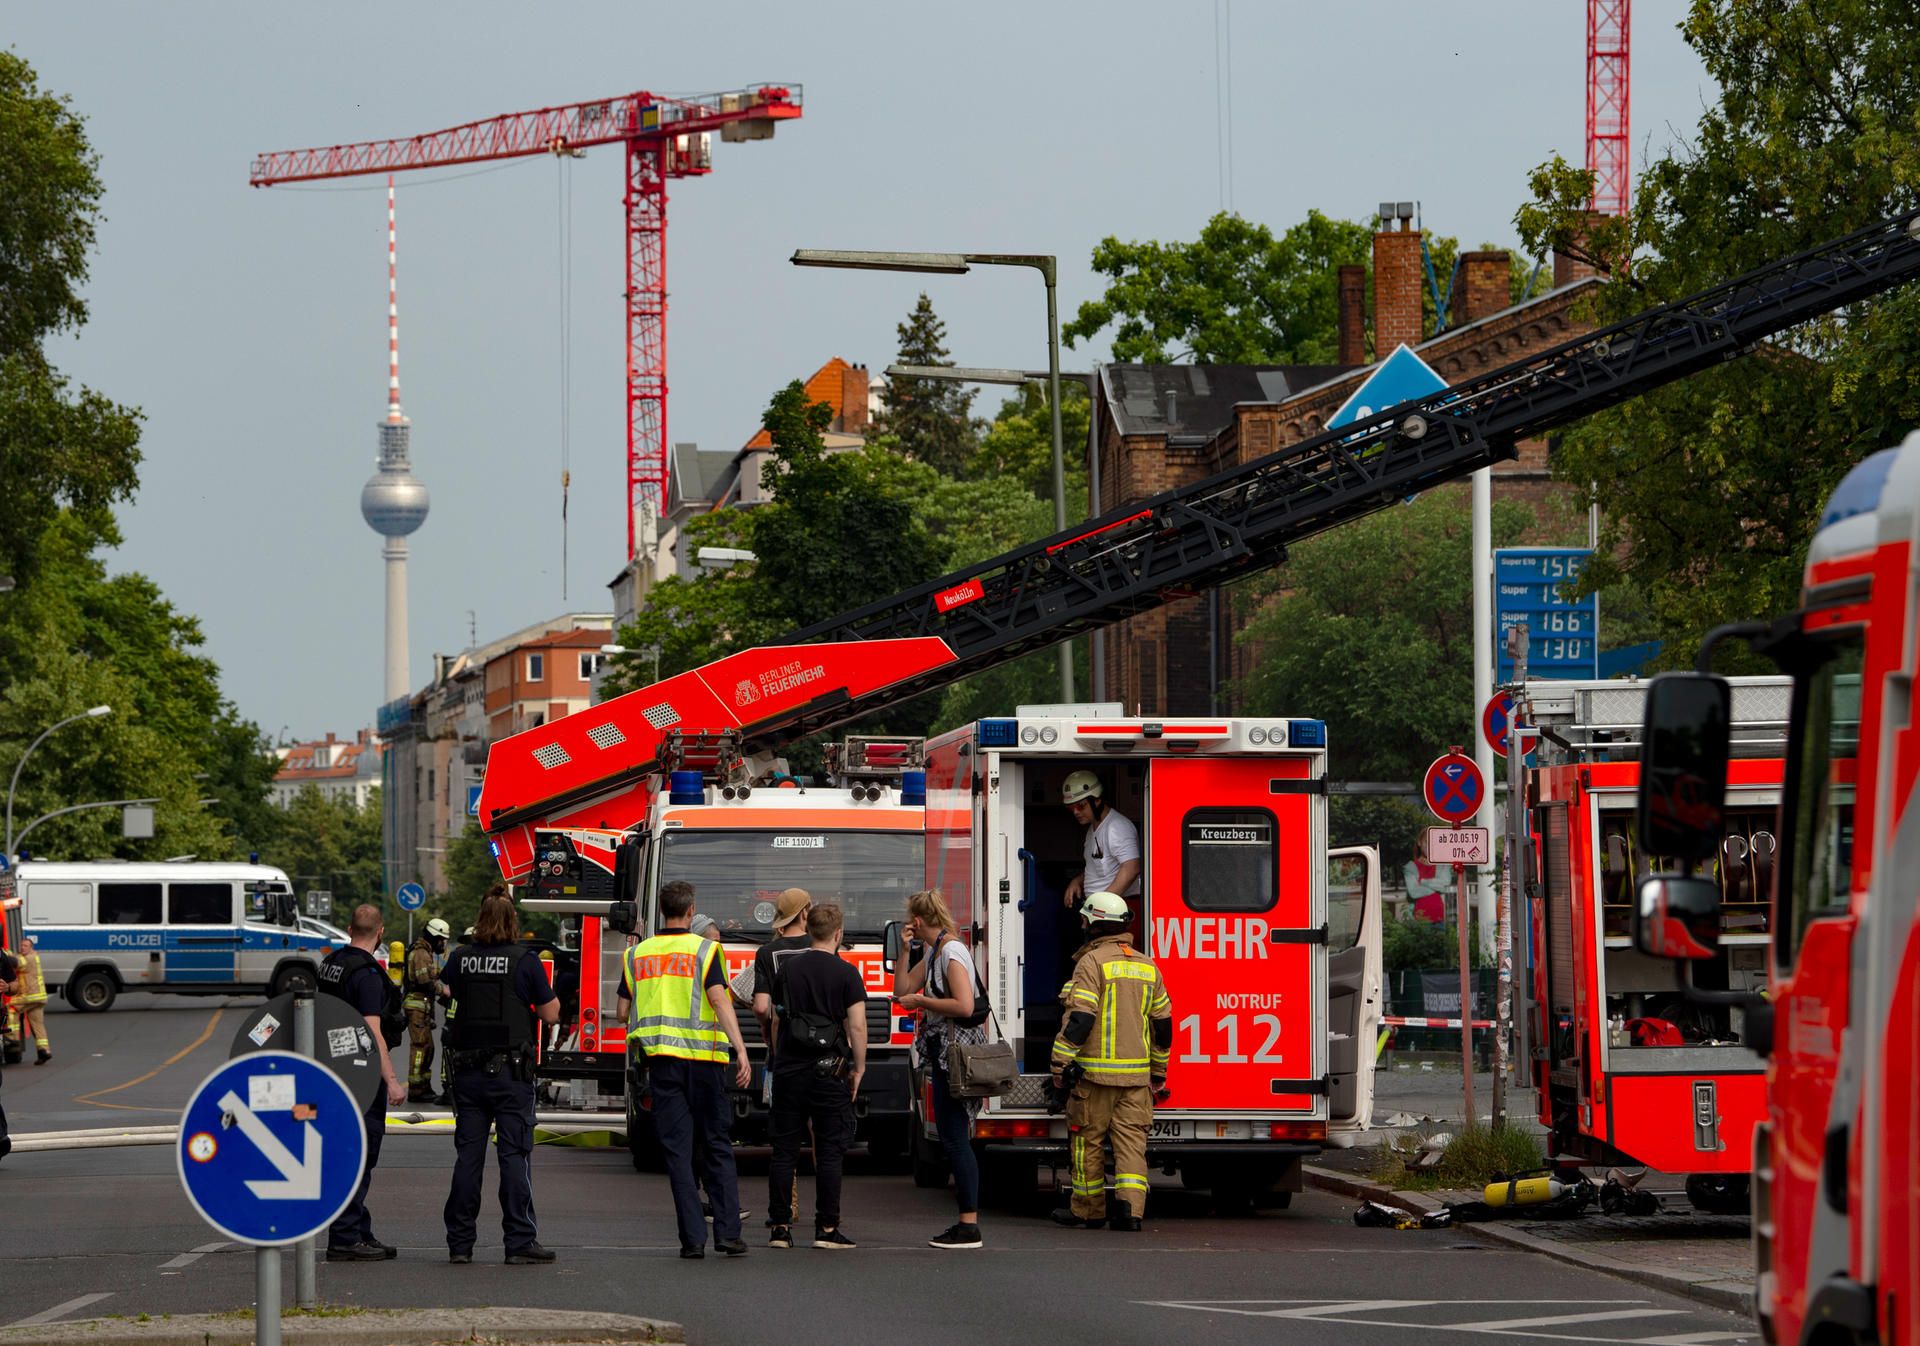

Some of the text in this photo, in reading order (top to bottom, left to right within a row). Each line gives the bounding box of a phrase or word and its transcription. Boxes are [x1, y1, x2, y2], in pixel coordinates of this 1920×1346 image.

[944, 587, 975, 606] Neukölln
[1501, 584, 1579, 604] Super 15
[1501, 612, 1528, 622] Super
[1543, 612, 1580, 632] 166
[1543, 639, 1580, 659] 130
[759, 660, 802, 684] BERLINER
[762, 665, 826, 697] FEUERWEHR
[776, 837, 818, 848] LHF 1100/1
[1201, 828, 1257, 841] Kreuzberg
[1439, 833, 1479, 844] ab 20.05.19
[1453, 848, 1466, 858] 07h
[108, 934, 161, 946] POLIZEI
[1150, 917, 1268, 959] WEHR
[461, 956, 509, 974] POLIZEI
[635, 953, 693, 979] POLZEI
[1216, 993, 1282, 1009] NOTRUF
[1179, 1014, 1283, 1064] 112
